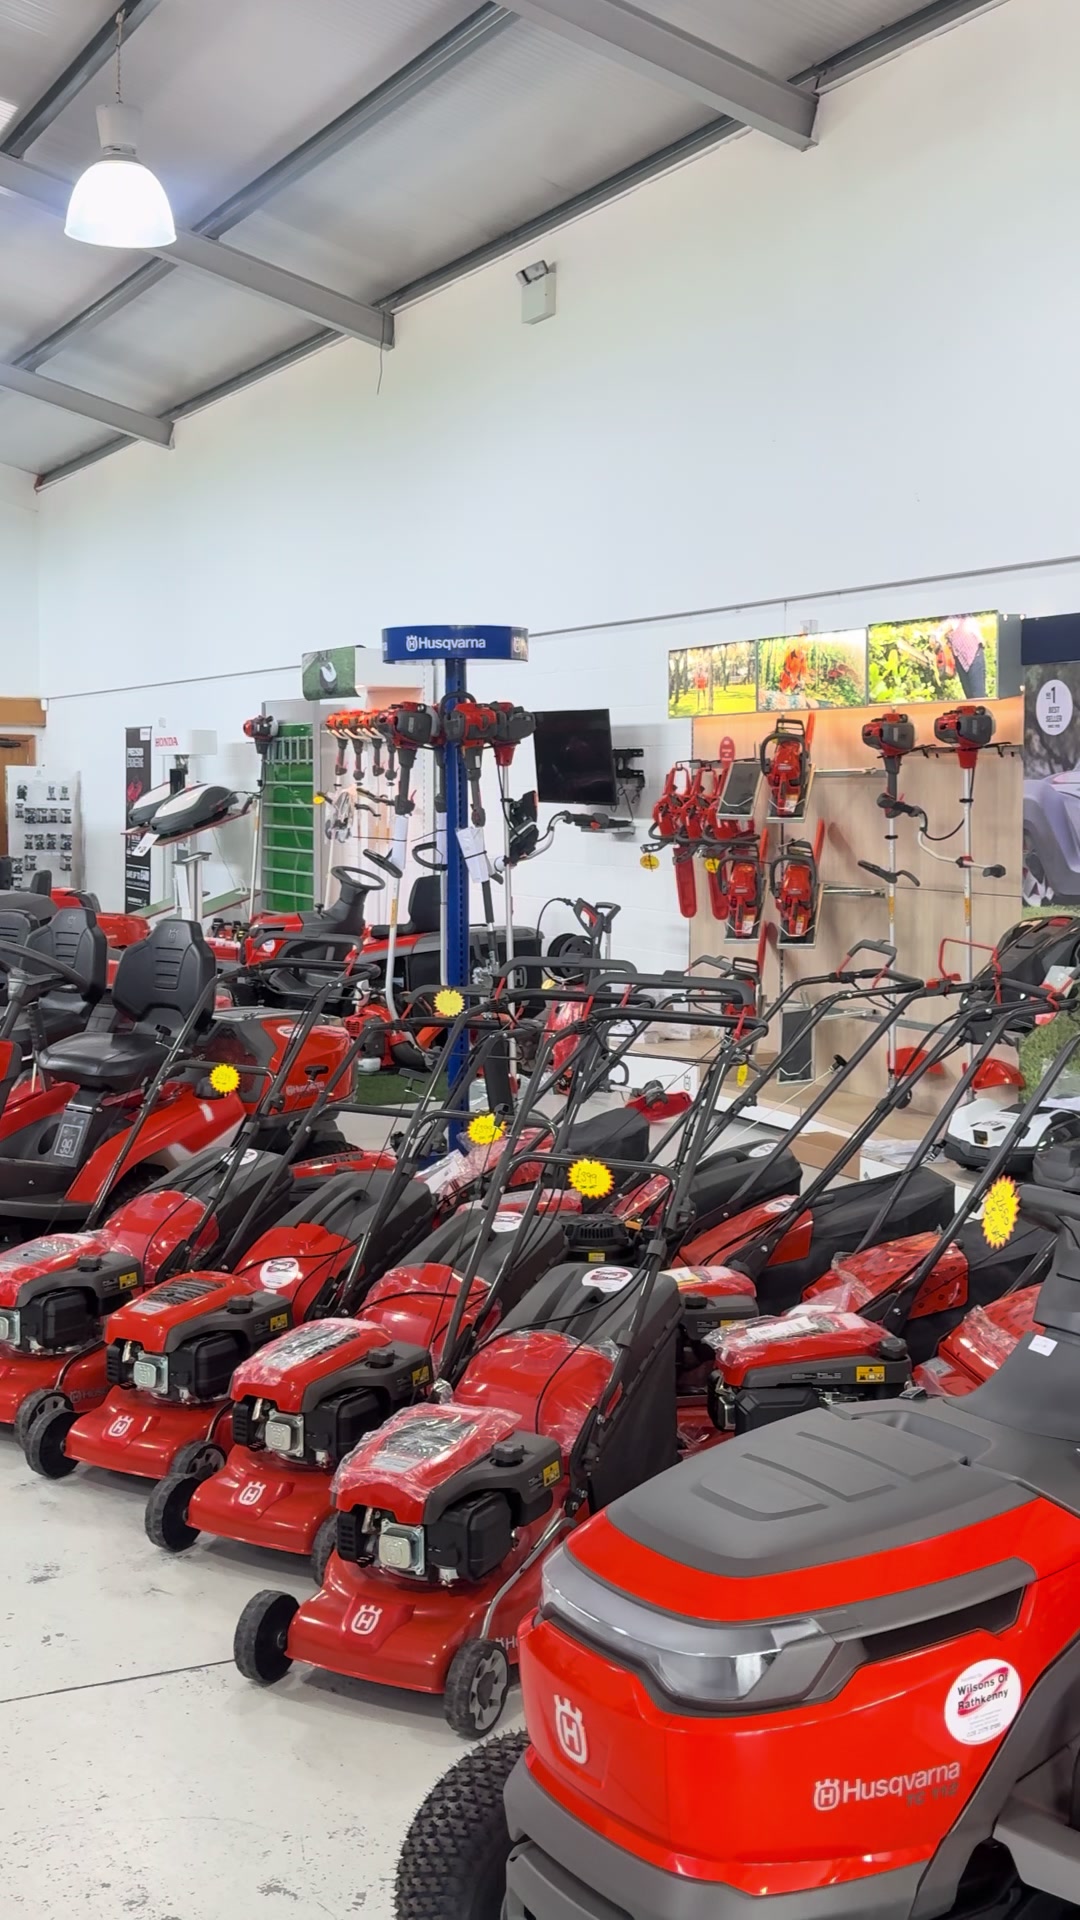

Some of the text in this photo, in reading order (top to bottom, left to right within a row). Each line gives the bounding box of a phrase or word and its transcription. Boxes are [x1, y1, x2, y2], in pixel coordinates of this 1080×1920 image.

[419, 637, 486, 651] Husqvarna
[155, 737, 179, 747] HONDA
[957, 1679, 996, 1696] Wilsons
[997, 1673, 1009, 1684] Of
[957, 1688, 1009, 1711] Rathkenny
[842, 1761, 960, 1803] Husqvarna
